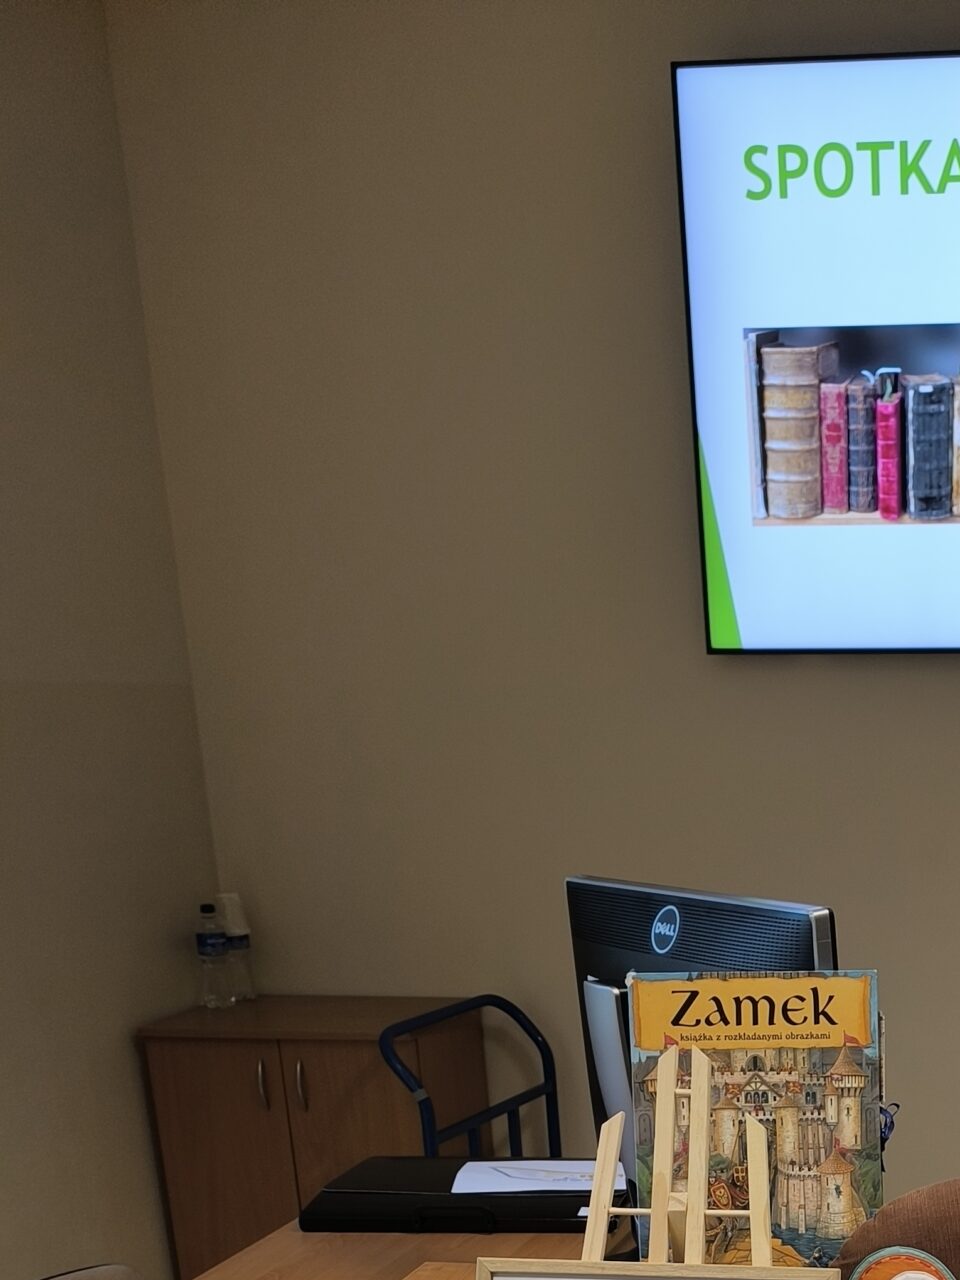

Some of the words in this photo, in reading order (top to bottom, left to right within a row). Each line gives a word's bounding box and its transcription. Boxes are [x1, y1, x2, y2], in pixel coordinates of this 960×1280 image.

[655, 922, 676, 936] DELL
[670, 987, 839, 1027] Zamek
[680, 1033, 713, 1044] książka
[785, 1031, 831, 1041] obrazkami
